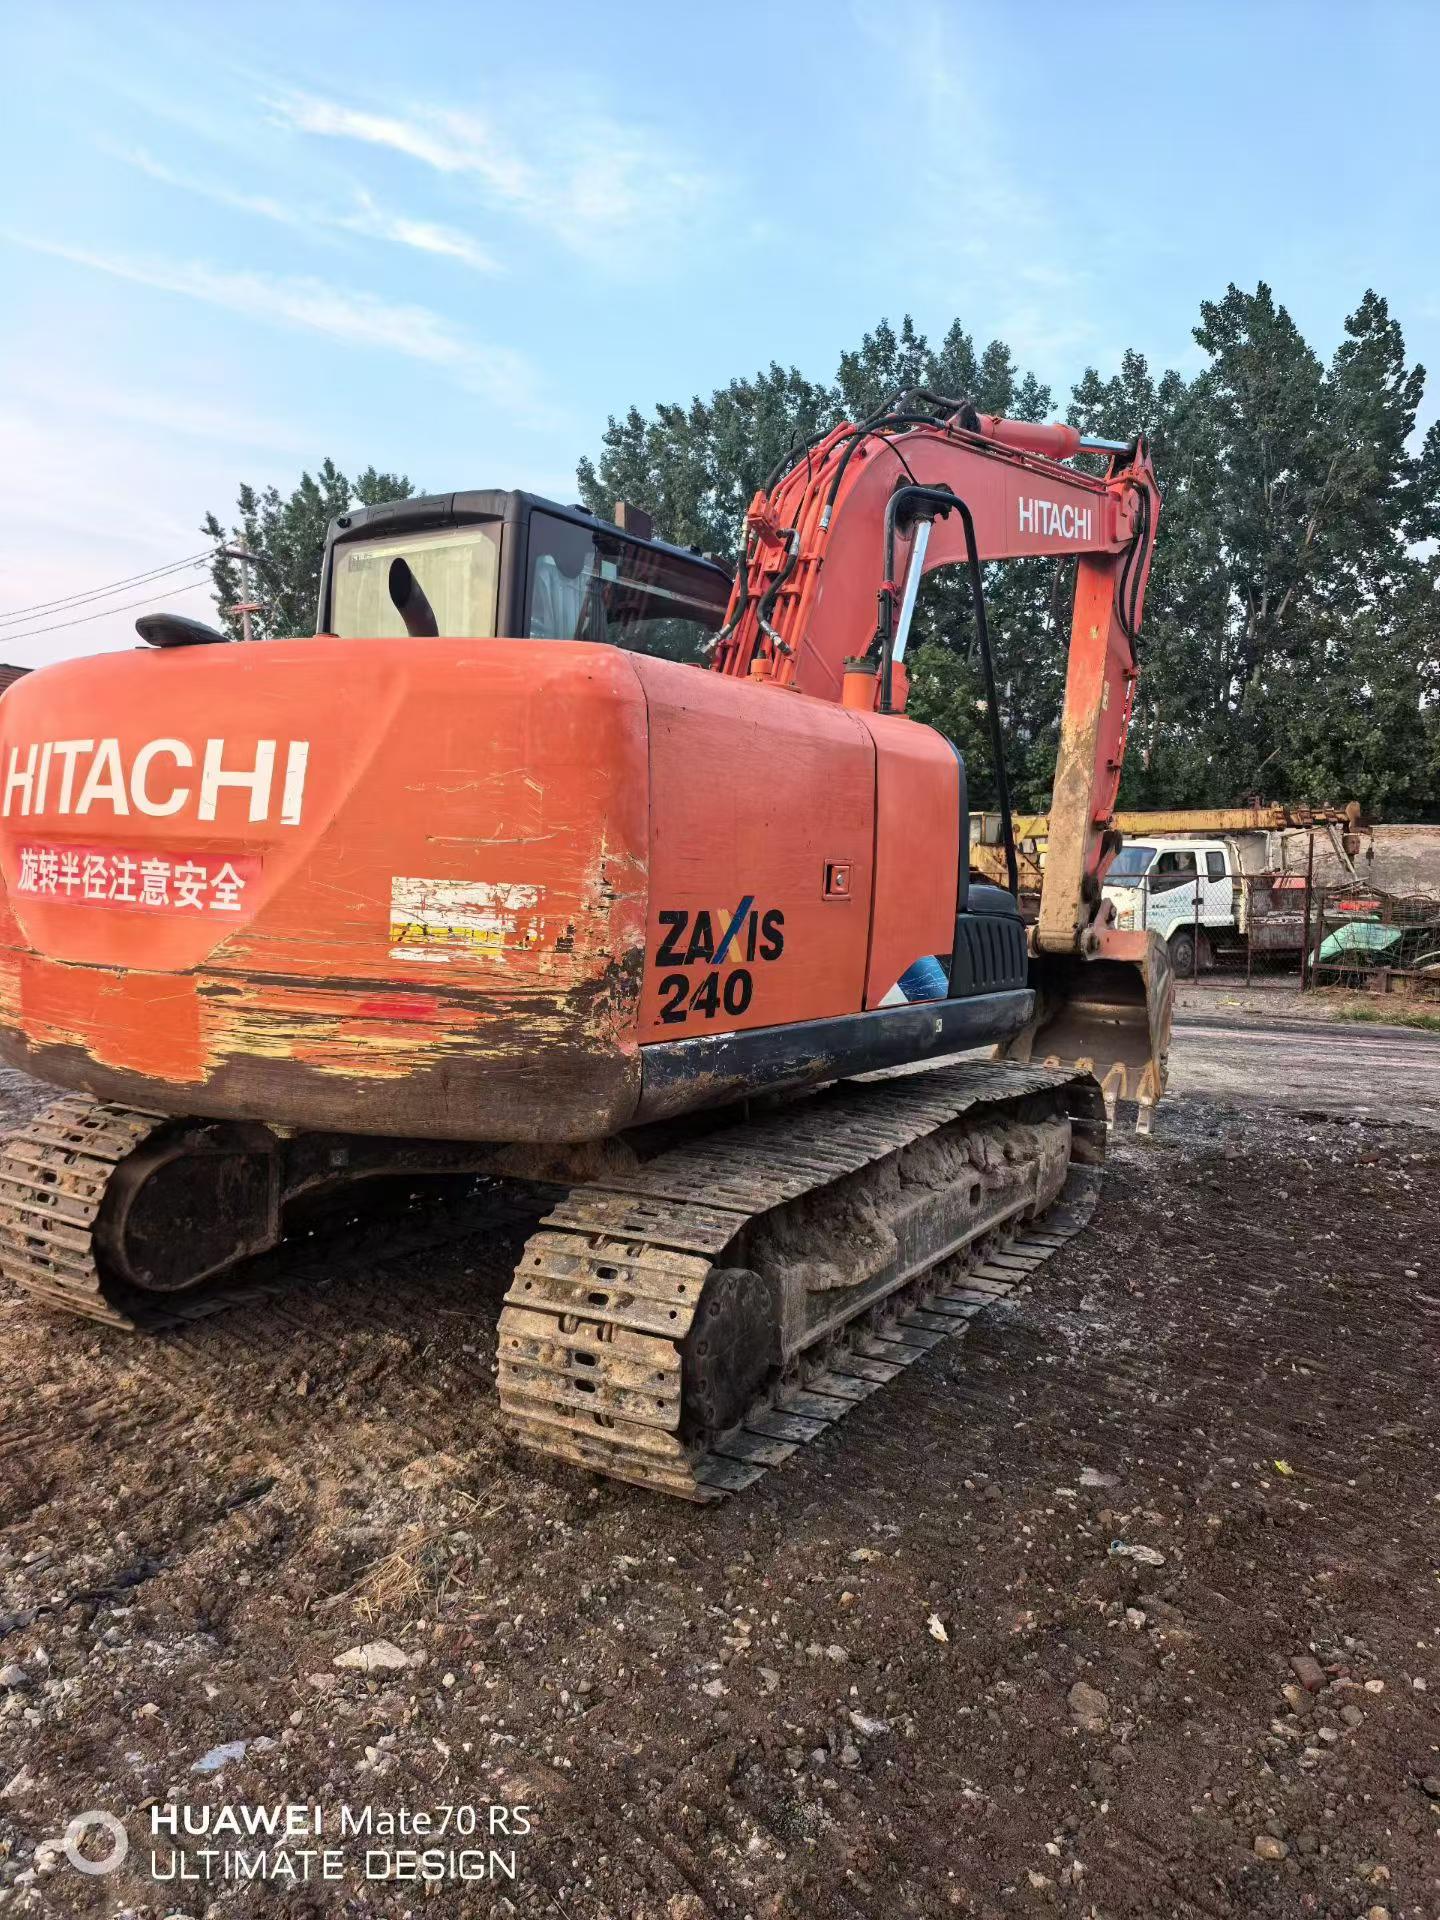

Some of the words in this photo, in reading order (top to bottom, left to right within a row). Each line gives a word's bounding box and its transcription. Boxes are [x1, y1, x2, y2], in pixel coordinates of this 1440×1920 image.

[1018, 496, 1091, 541] HITACHI
[3, 738, 310, 825] HITACHI
[18, 848, 246, 911] 旋转半径注意安全
[655, 896, 785, 967] ZAXIS
[657, 968, 753, 1024] 240
